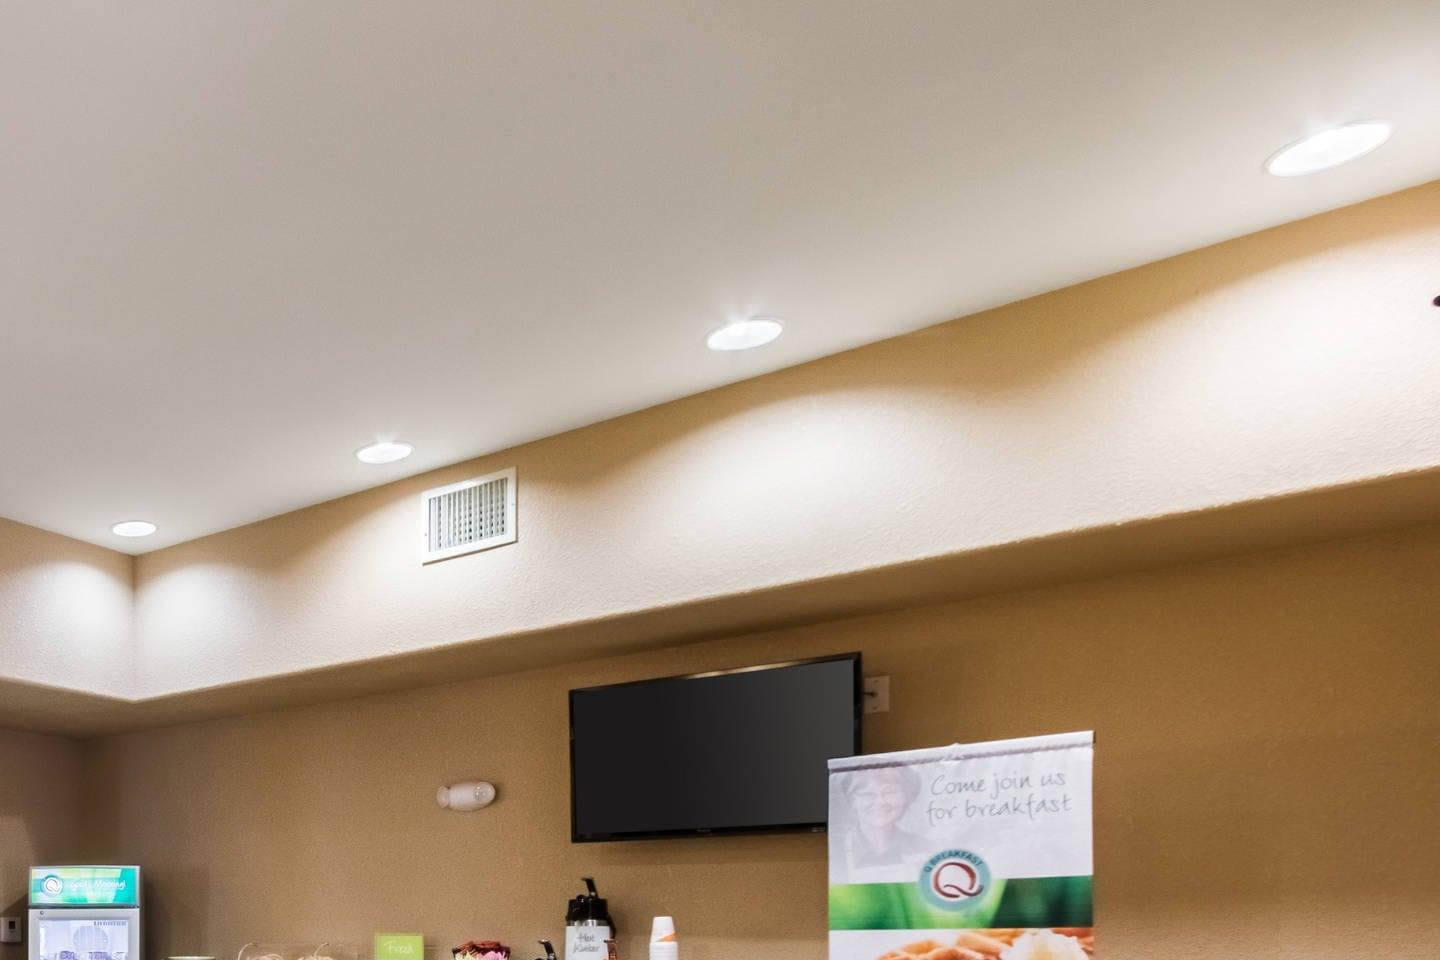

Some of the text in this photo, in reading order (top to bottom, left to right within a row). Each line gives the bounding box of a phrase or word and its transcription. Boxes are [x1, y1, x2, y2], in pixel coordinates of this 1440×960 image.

[930, 771, 1067, 800] Come join us
[926, 793, 1073, 827] for breakfast
[933, 861, 985, 899] Q
